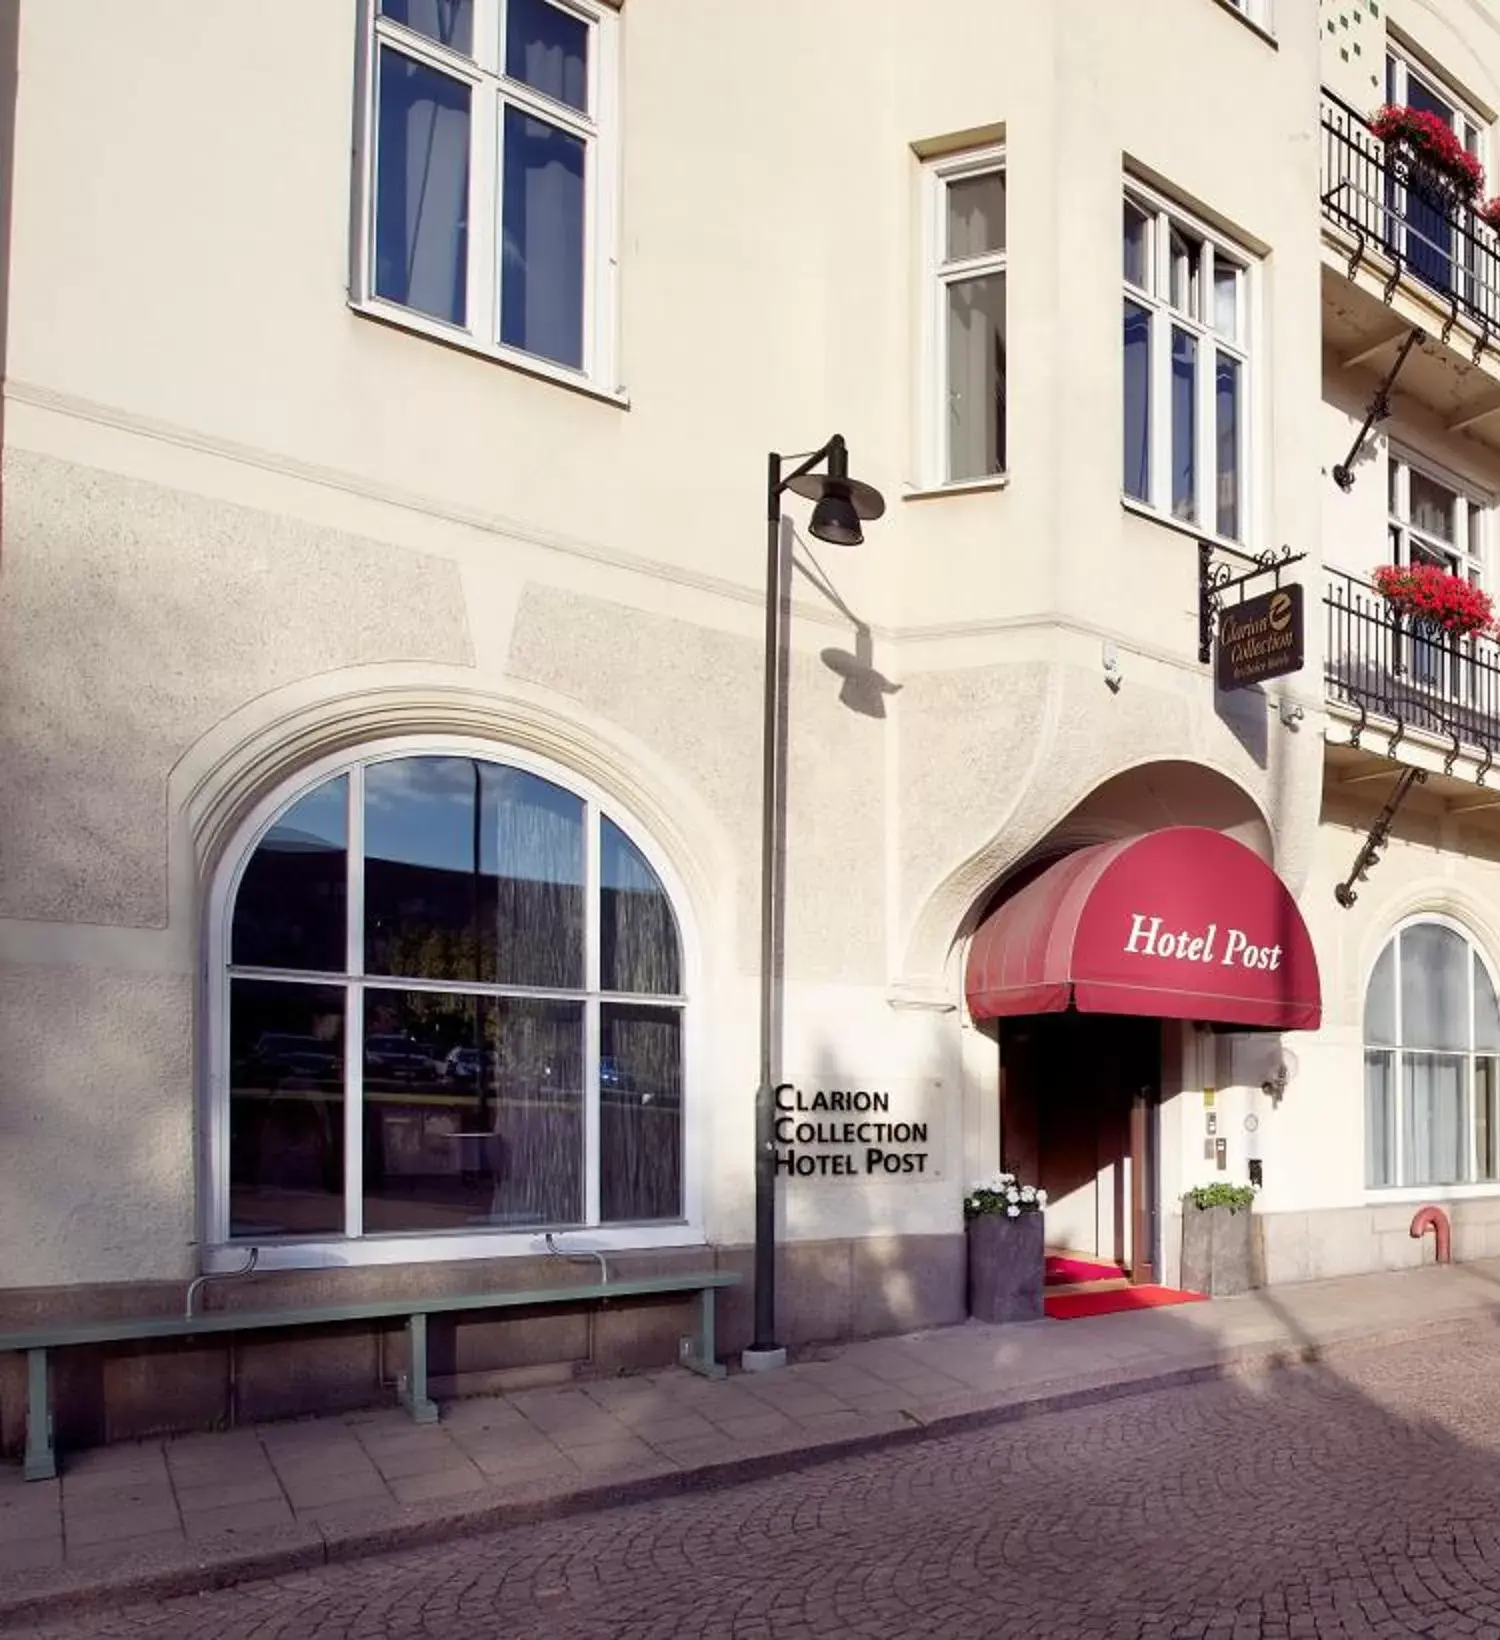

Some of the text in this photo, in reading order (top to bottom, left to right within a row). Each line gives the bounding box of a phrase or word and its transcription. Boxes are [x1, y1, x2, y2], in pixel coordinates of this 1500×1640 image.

[1124, 913, 1283, 971] Hotel Post
[775, 1083, 889, 1112] CLARION
[775, 1116, 928, 1144] COLLECTION
[775, 1148, 929, 1176] HOTEL POST
